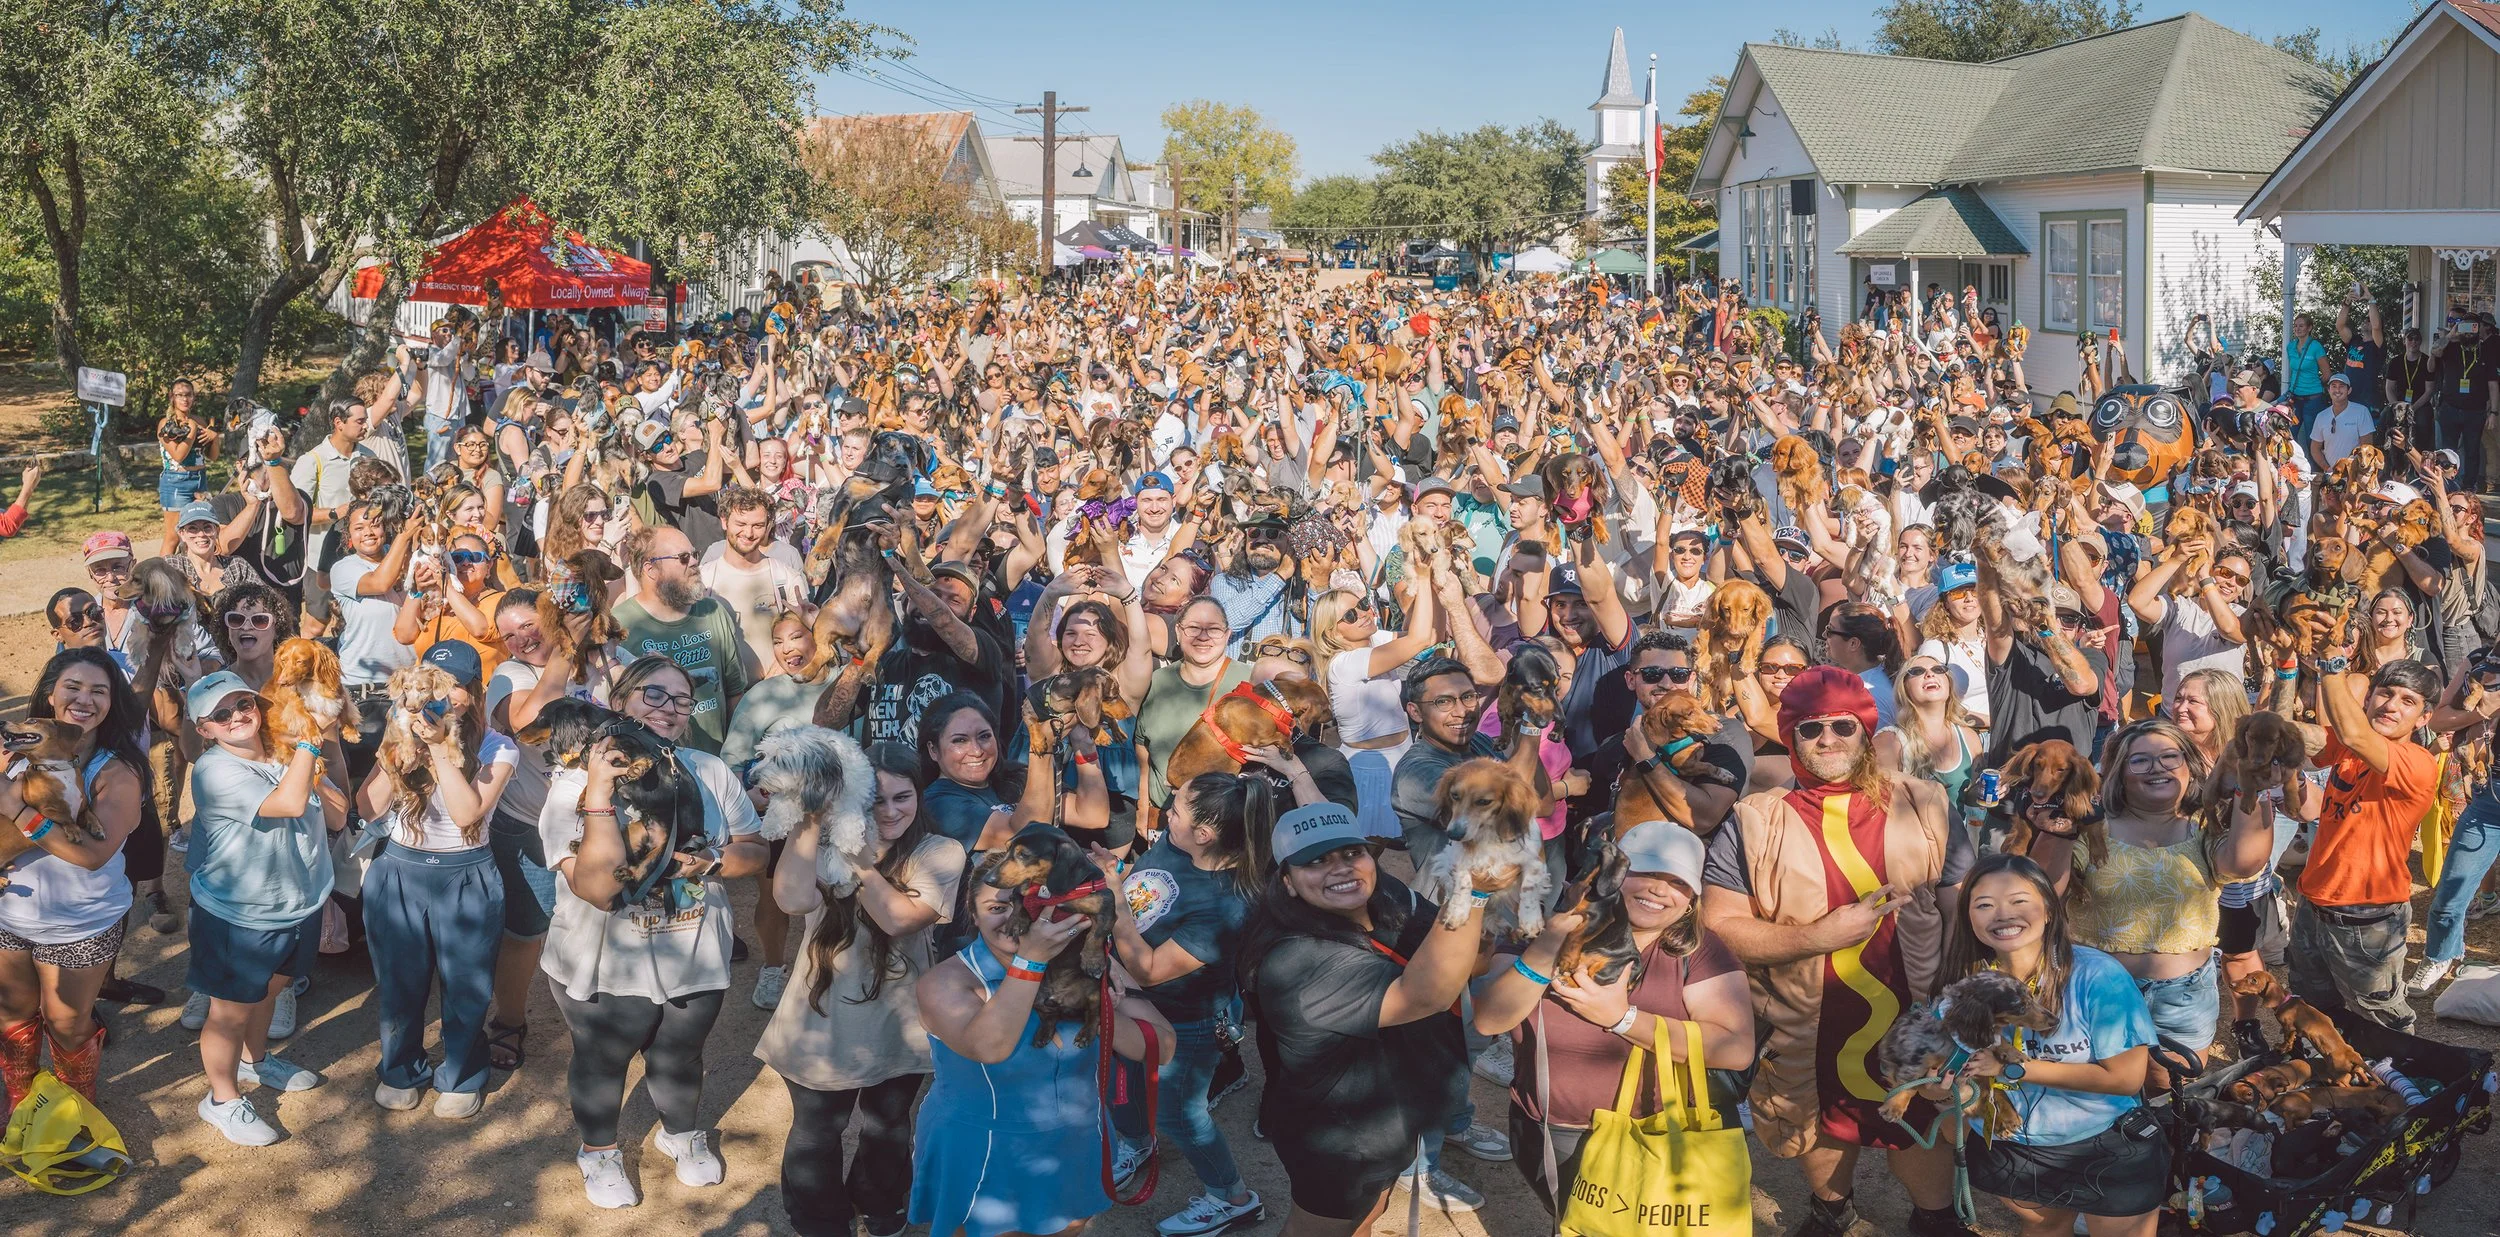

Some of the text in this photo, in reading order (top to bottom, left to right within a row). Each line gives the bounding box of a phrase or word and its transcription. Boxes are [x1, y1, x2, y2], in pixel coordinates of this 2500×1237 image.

[421, 282, 482, 292] EMERGENCY ROOM
[551, 284, 650, 302] Locally Owned. Always
[674, 647, 711, 667] Little
[869, 702, 897, 719] MEN
[1292, 814, 1350, 835] DOG MOM
[425, 855, 440, 864] alo
[1637, 1203, 1710, 1227] PEOPLE
